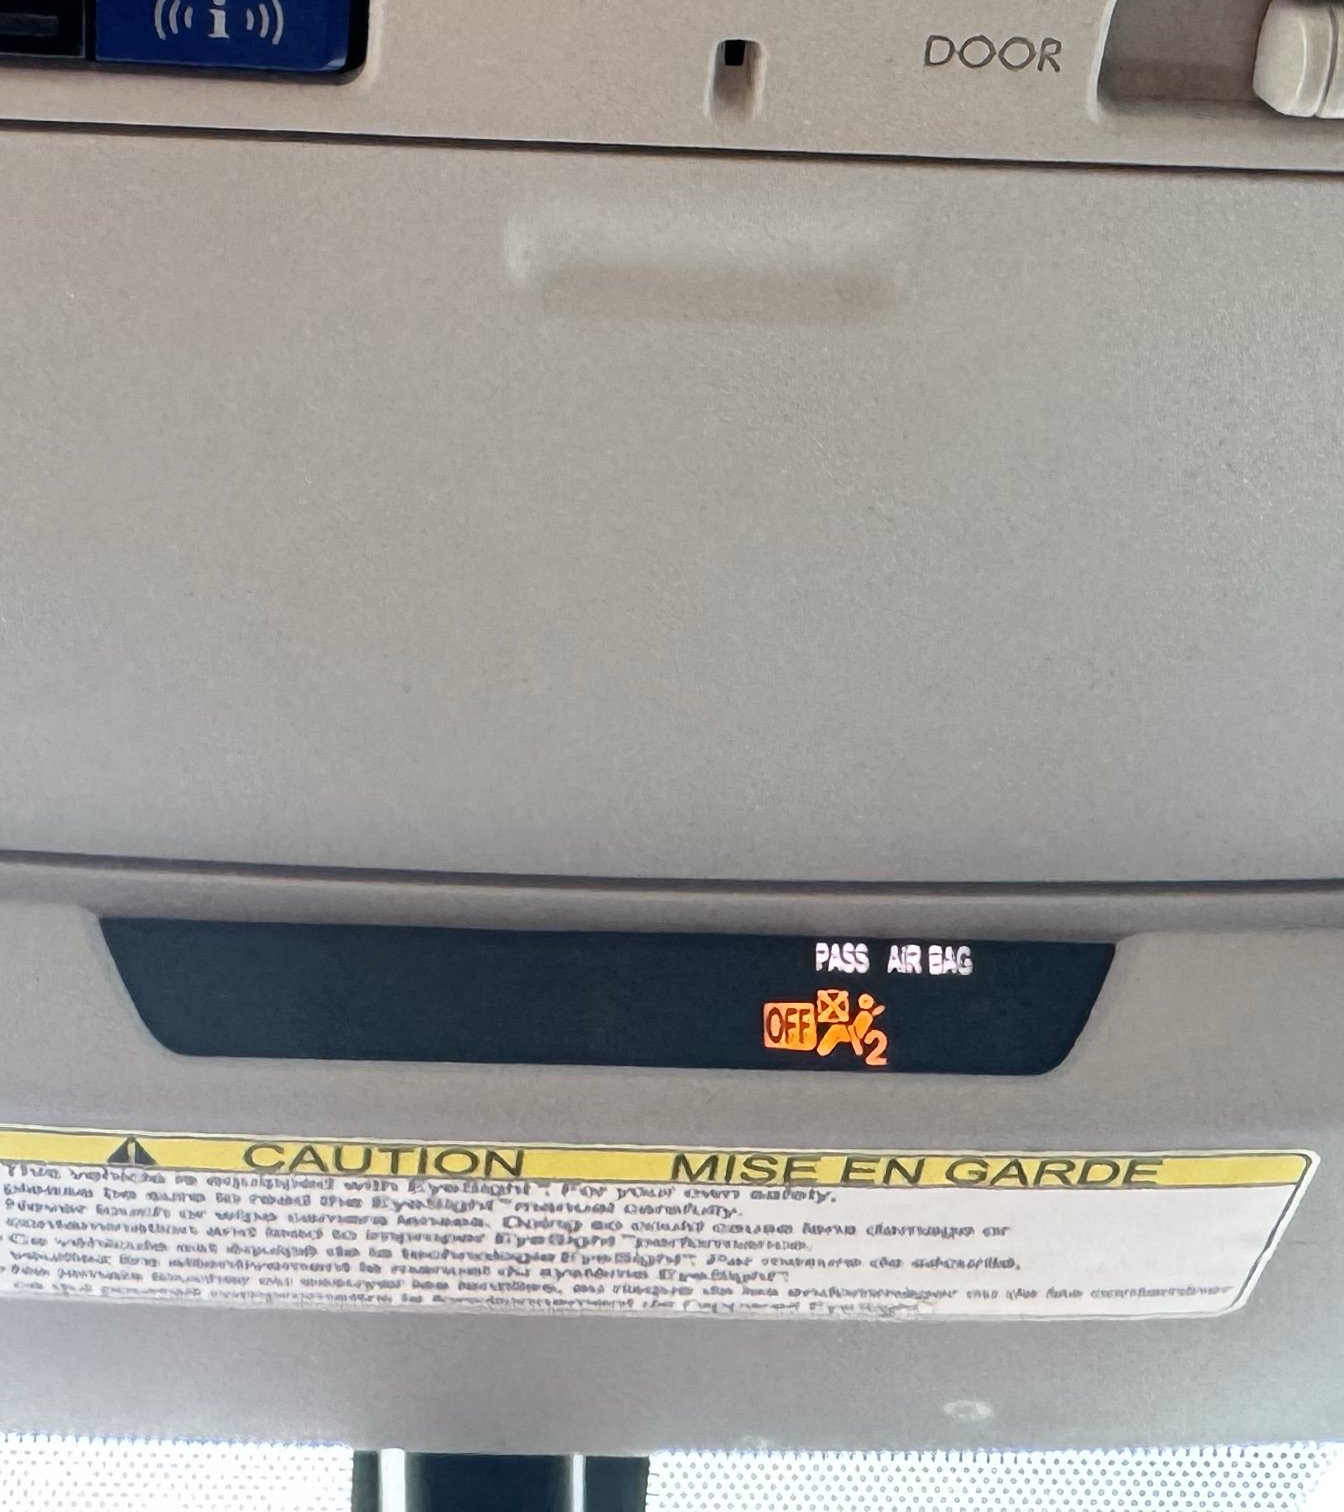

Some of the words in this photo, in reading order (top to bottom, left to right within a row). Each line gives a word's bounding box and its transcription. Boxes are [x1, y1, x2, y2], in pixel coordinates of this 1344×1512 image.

[923, 34, 1065, 73] DOOR
[815, 942, 871, 974] PASS
[887, 943, 923, 975] AIR
[928, 944, 974, 976] BAG
[766, 1006, 812, 1044] OFF
[864, 1029, 888, 1067] 2
[243, 1142, 526, 1178] CAUTION
[672, 1153, 822, 1185] MISE
[841, 1155, 927, 1186] EN
[945, 1157, 1164, 1187] GARDE
[344, 1180, 398, 1192] with
[562, 1183, 607, 1197] For
[617, 1186, 675, 1201] your
[685, 1187, 739, 1199] own
